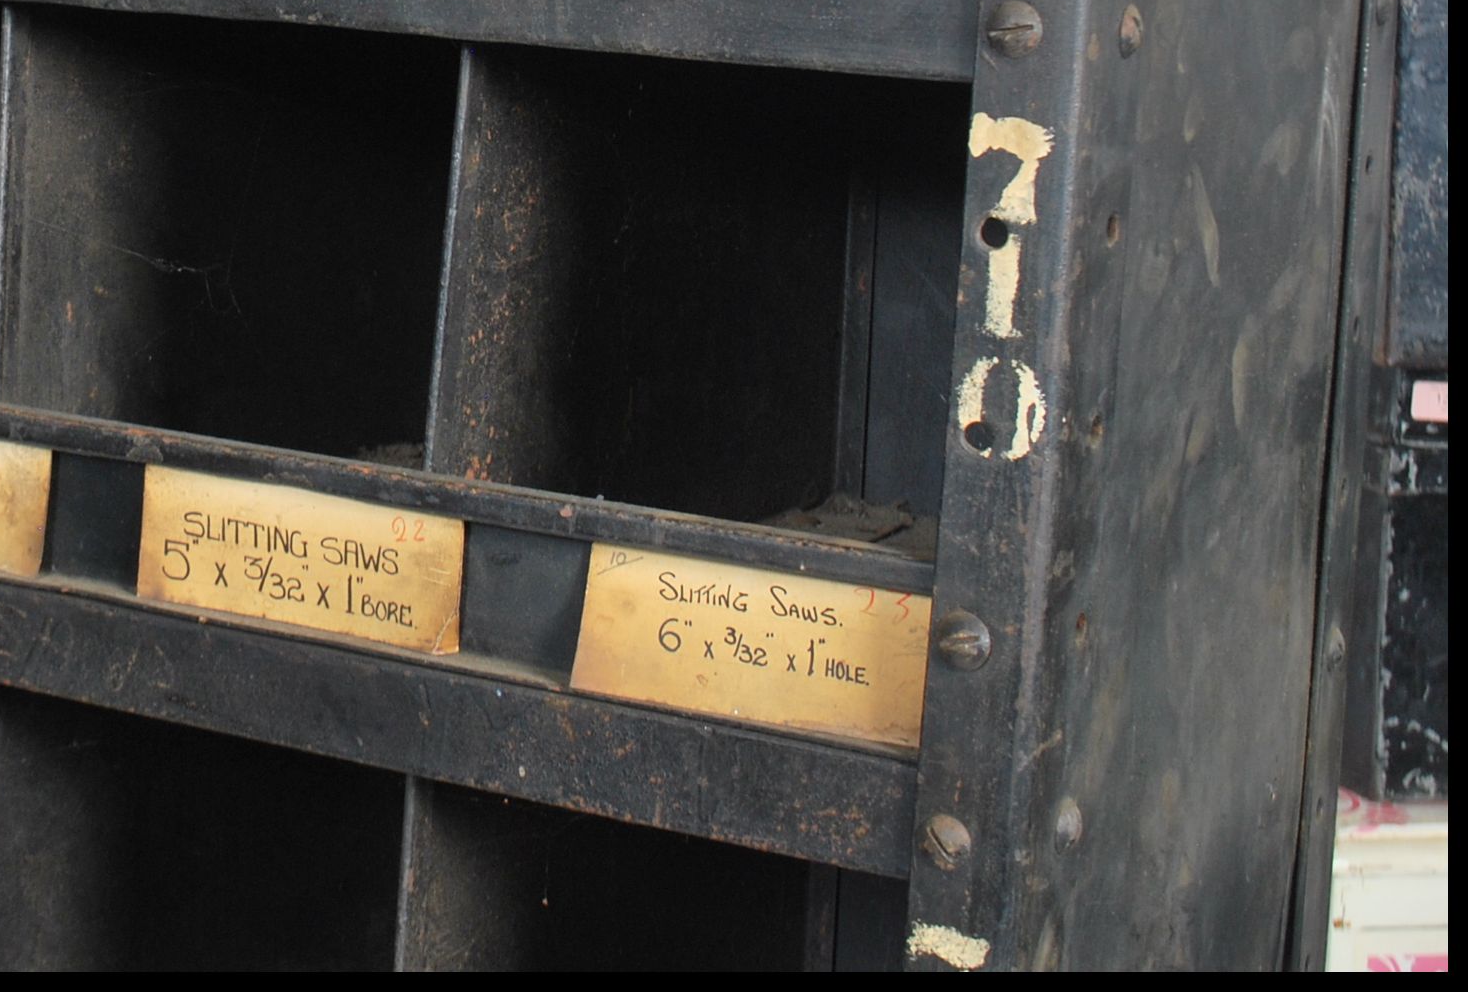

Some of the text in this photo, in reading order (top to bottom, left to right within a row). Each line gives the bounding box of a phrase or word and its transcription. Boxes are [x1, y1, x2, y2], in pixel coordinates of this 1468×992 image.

[182, 510, 400, 576] SLITTING SAWS
[390, 515, 427, 543] 22
[161, 537, 200, 582] 5"
[243, 554, 310, 604] 3/32"
[345, 573, 365, 616] 1"
[657, 570, 844, 628] SLITTING SAWS.
[657, 616, 694, 653] 6"
[703, 639, 715, 660] x
[723, 625, 775, 668] 3/32"
[786, 652, 797, 673] x
[806, 637, 826, 678] 1"
